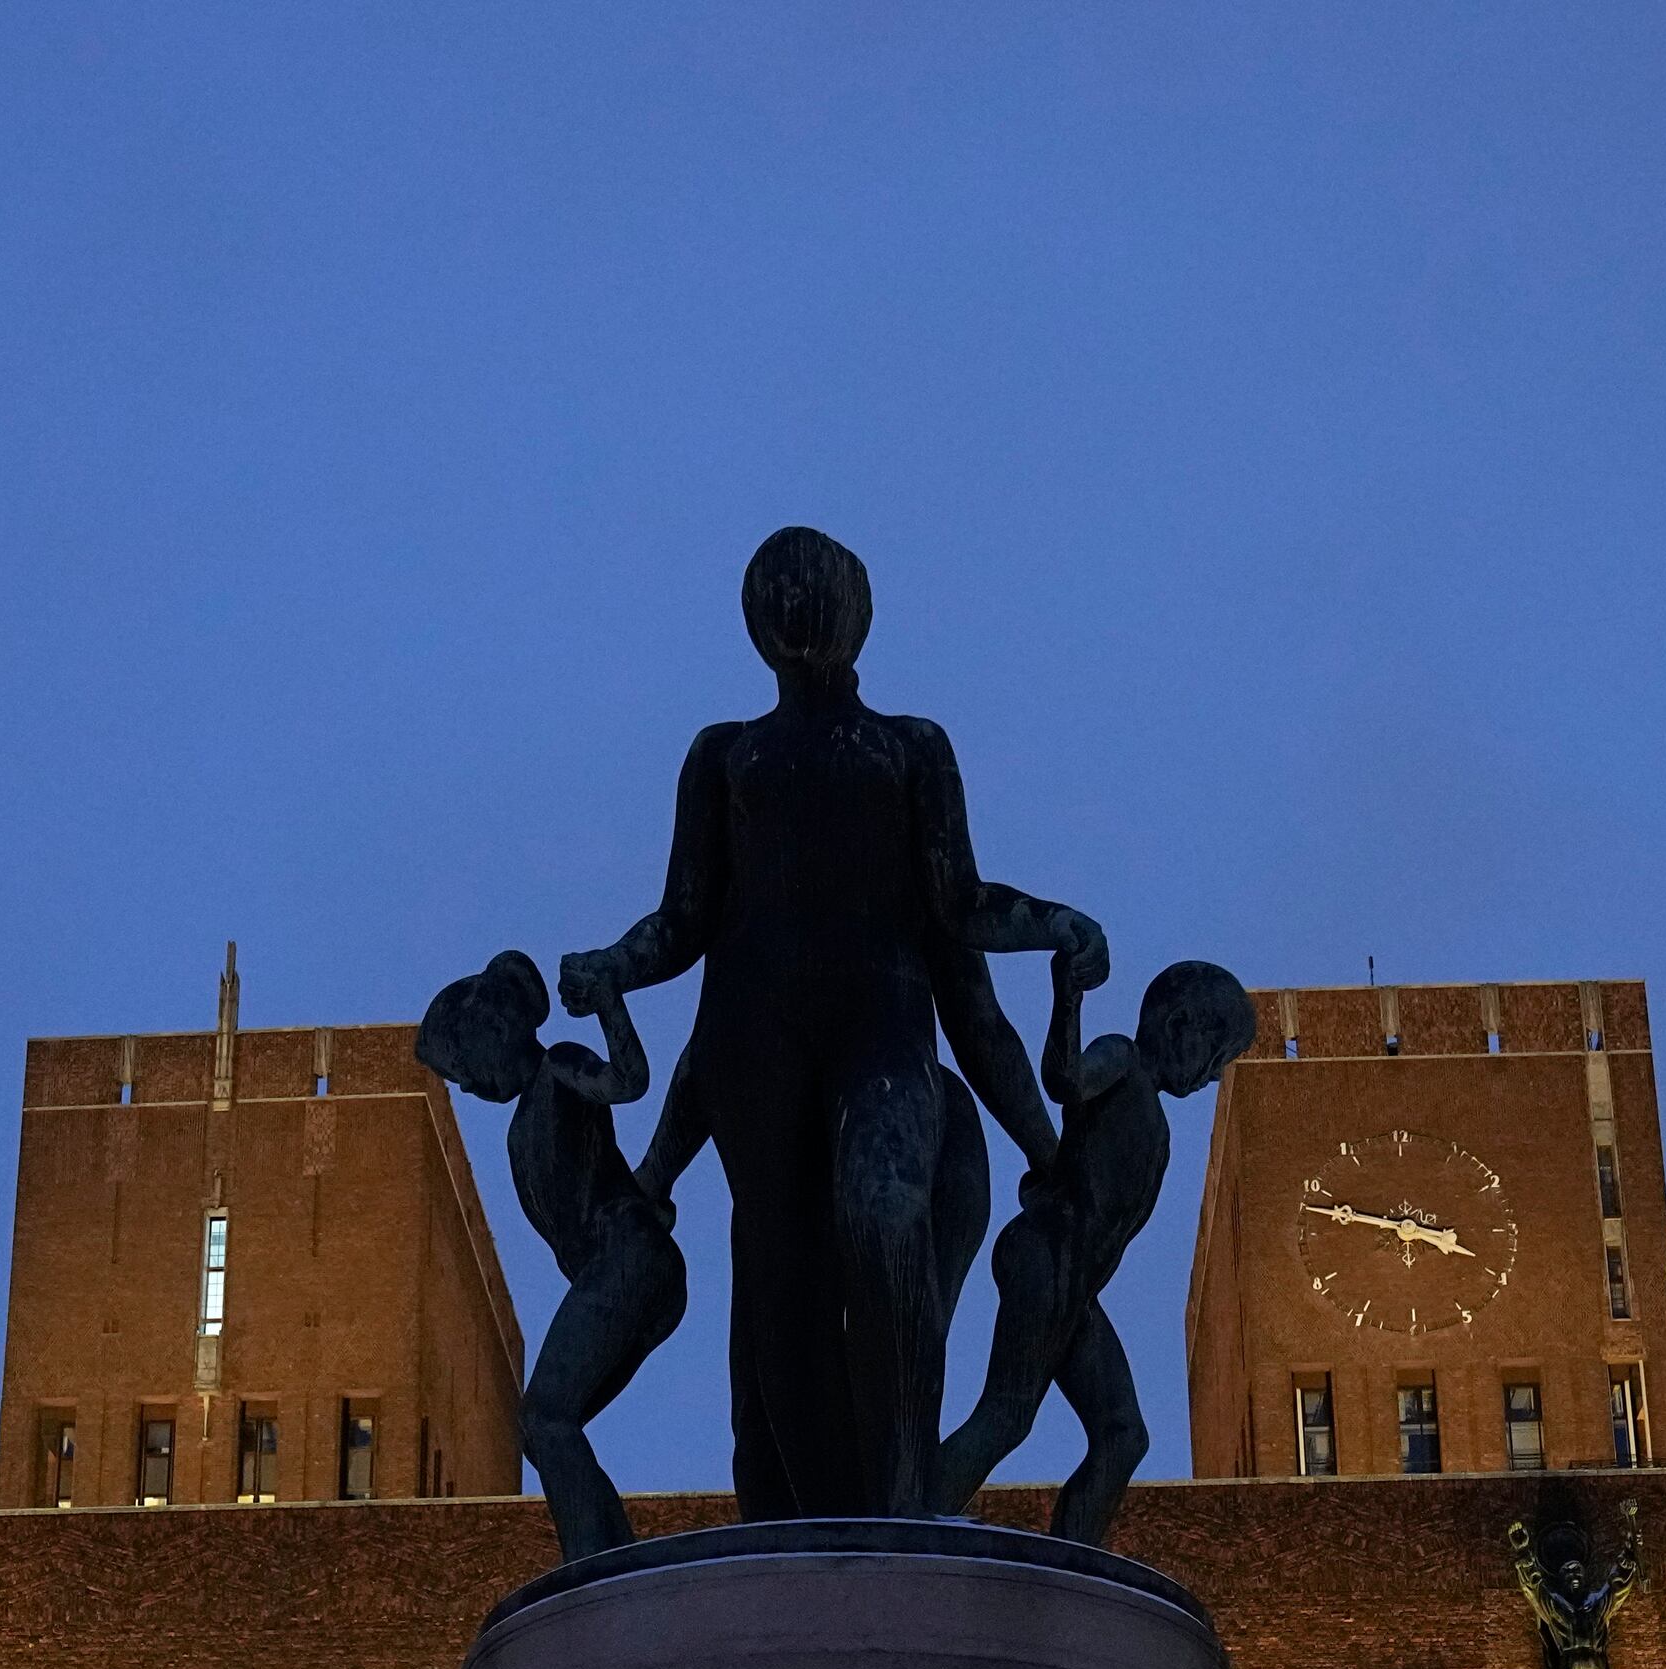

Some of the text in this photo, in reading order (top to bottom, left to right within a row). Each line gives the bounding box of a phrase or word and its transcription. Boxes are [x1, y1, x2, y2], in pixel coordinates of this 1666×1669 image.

[1391, 1129, 1409, 1143] 12
[1303, 1178, 1321, 1193] 10
[1489, 1174, 1501, 1188] 2
[1312, 1276, 1323, 1291] 8
[1354, 1313, 1365, 1328] 7
[1461, 1310, 1473, 1324] 5
